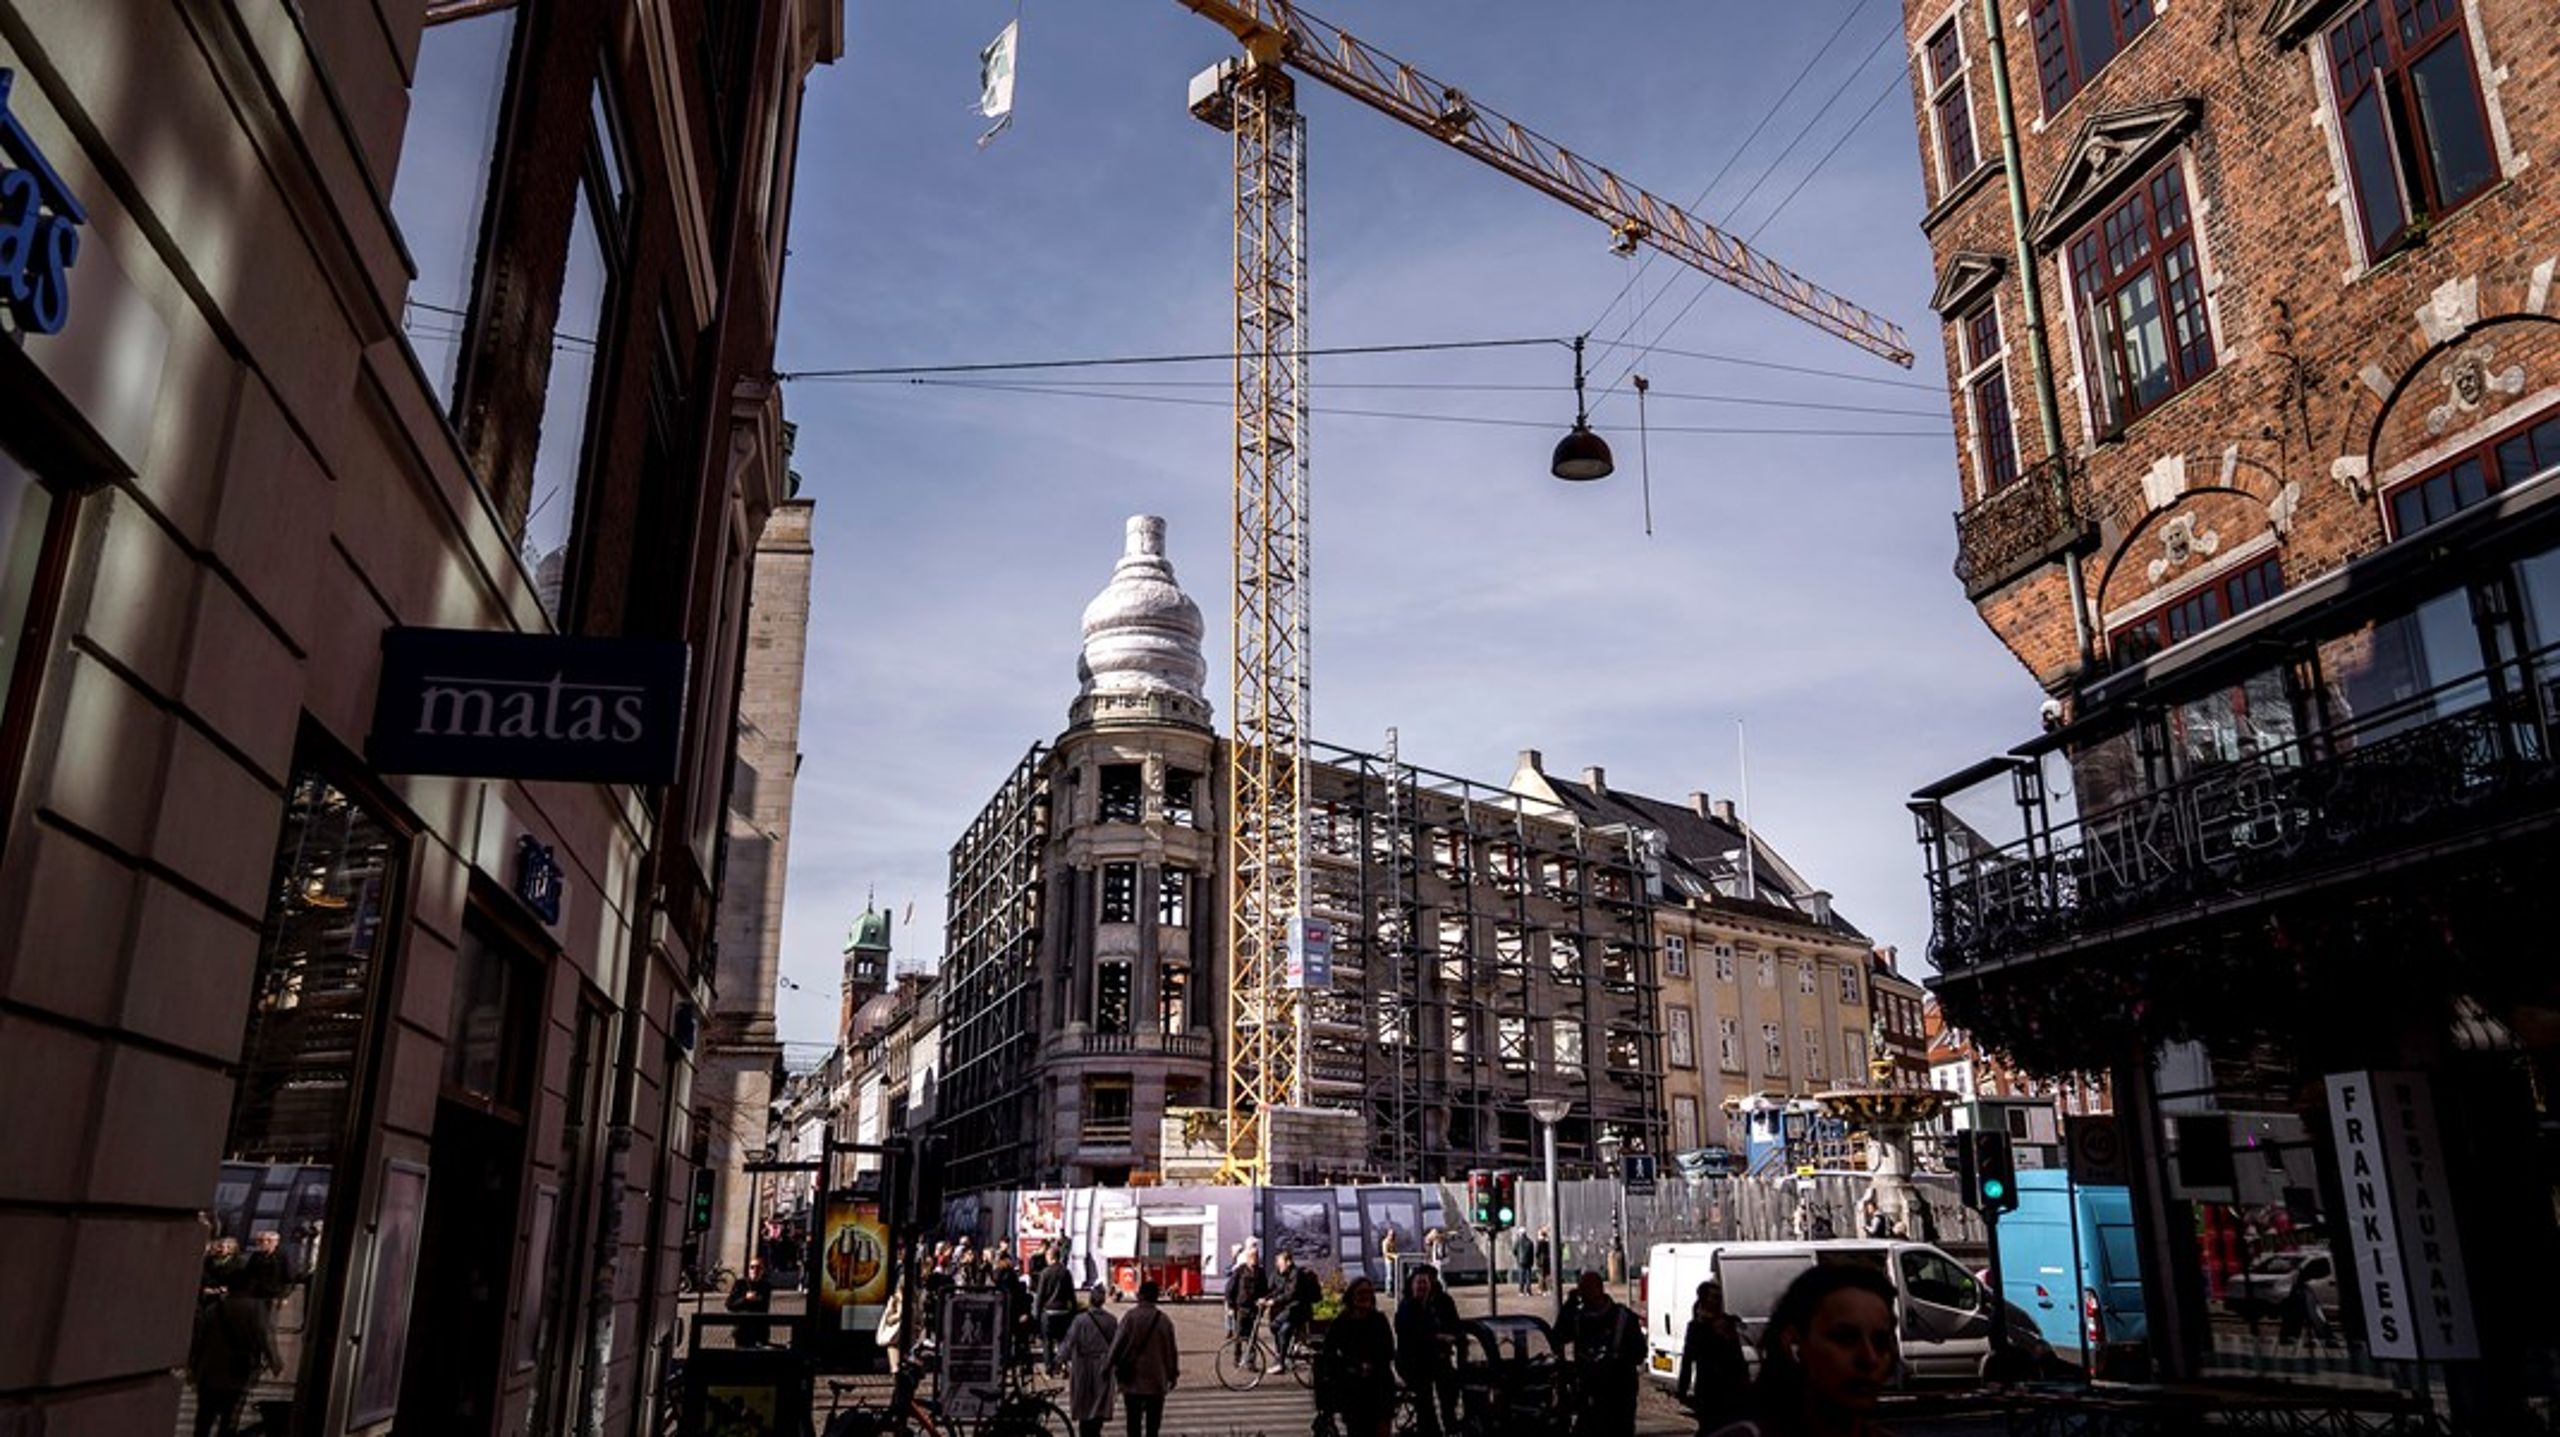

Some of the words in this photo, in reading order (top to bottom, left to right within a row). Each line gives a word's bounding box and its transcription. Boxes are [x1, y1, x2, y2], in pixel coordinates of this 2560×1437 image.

[414, 670, 646, 743] matas
[2343, 1086, 2397, 1343] FRANKIES
[2395, 1084, 2453, 1345] RESTAURANT
